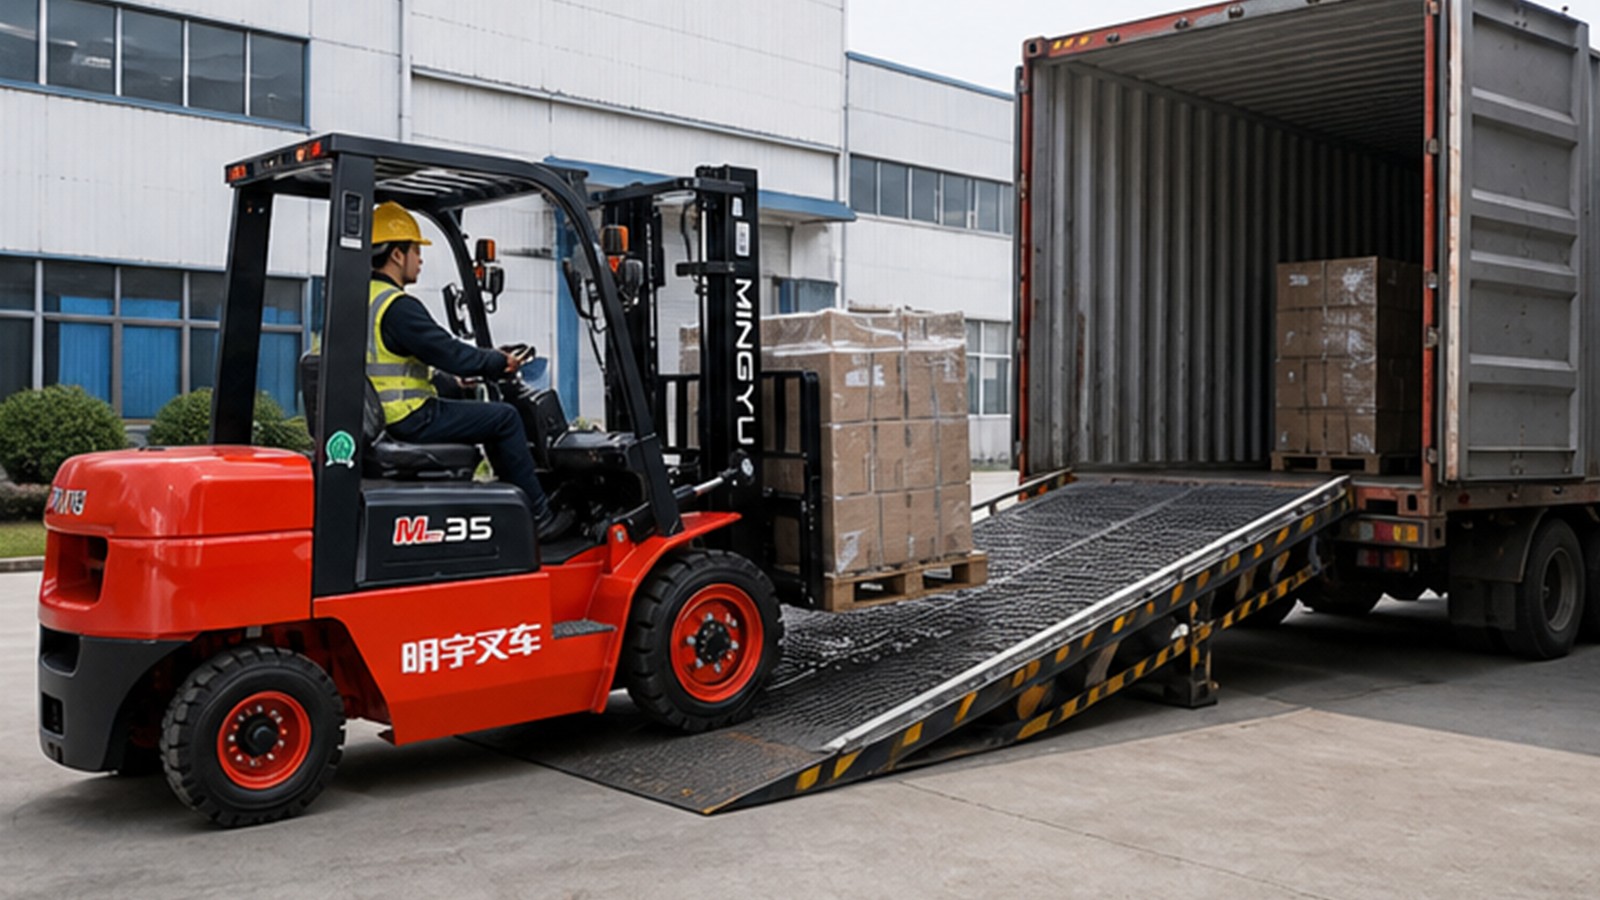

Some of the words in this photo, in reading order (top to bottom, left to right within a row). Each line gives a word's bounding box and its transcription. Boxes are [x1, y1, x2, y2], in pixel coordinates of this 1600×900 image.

[735, 278, 755, 444] MINGYU
[402, 623, 541, 674] 明宇叉车
